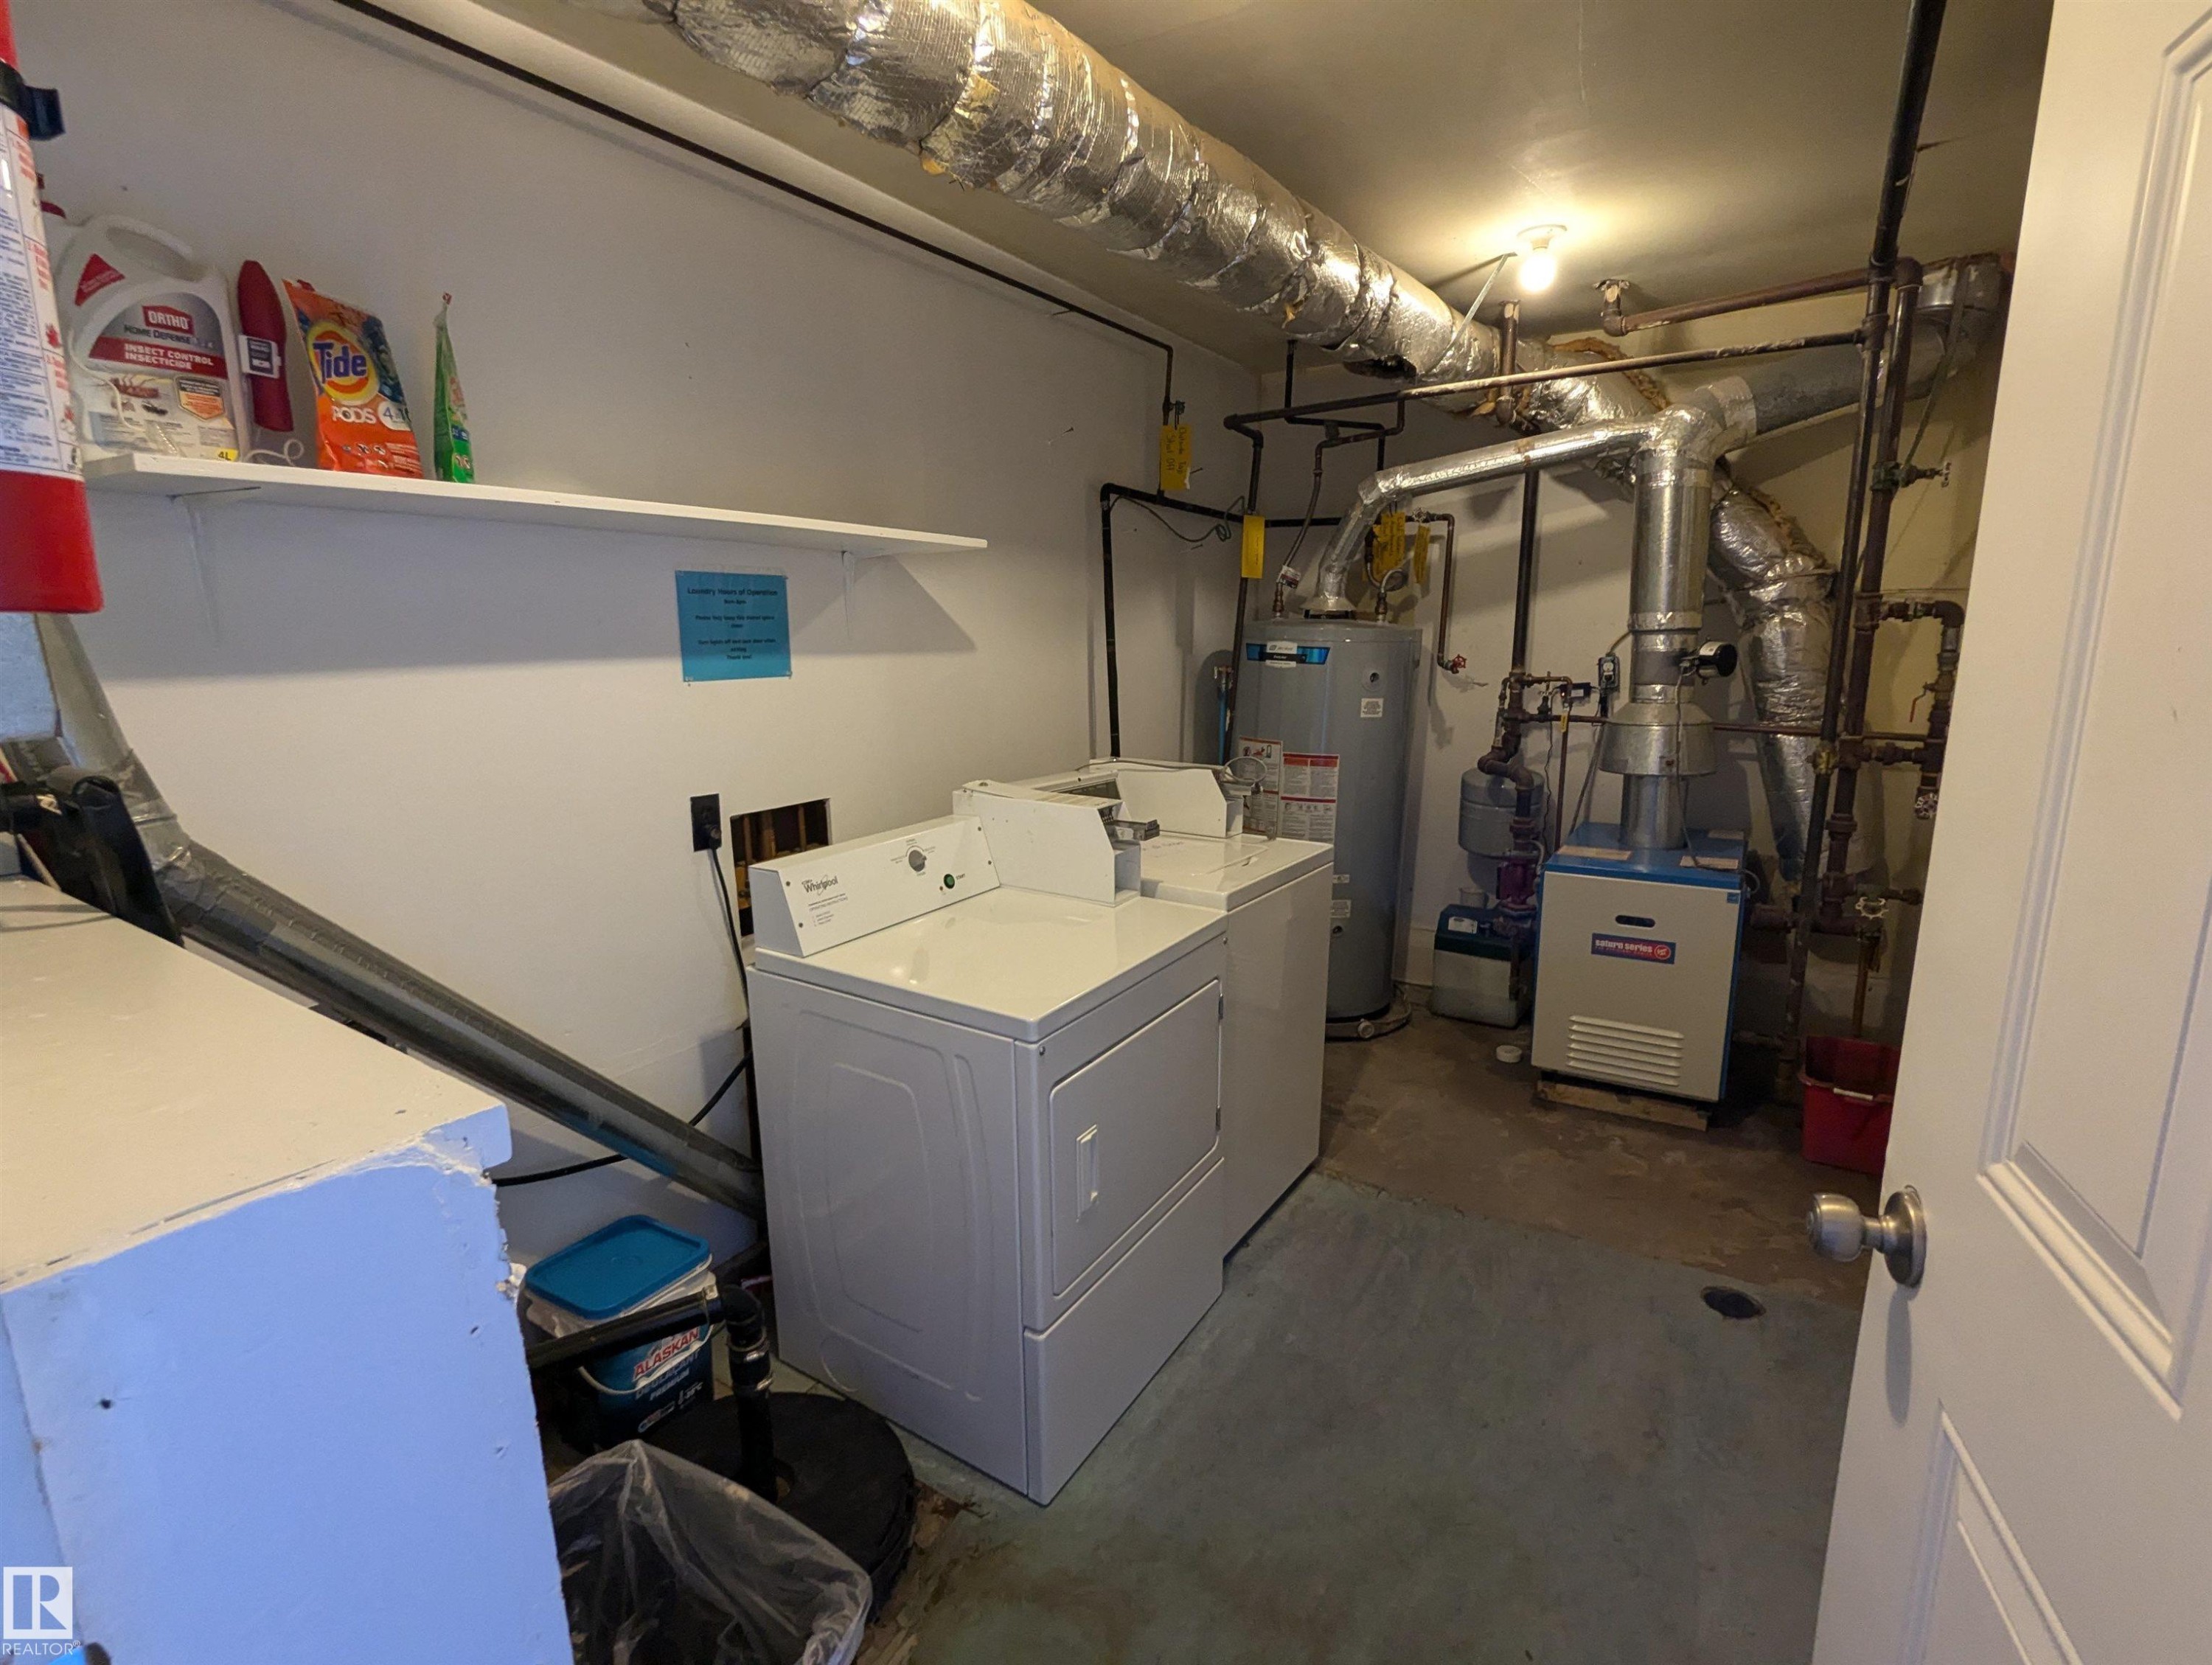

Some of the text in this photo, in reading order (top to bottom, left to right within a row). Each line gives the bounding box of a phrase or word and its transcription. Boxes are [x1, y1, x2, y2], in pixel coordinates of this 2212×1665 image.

[148, 310, 189, 330] ORTHO
[124, 324, 151, 337] HOME
[153, 330, 191, 344] DEFENSE
[124, 343, 215, 366] INSECT CONTROL
[124, 352, 192, 370] INSECTICIDE
[313, 342, 367, 383] Tide
[332, 406, 377, 425] PODS
[804, 875, 838, 893] Whirlpool
[1624, 943, 1653, 953] series
[634, 1328, 700, 1378] ALASKAN
